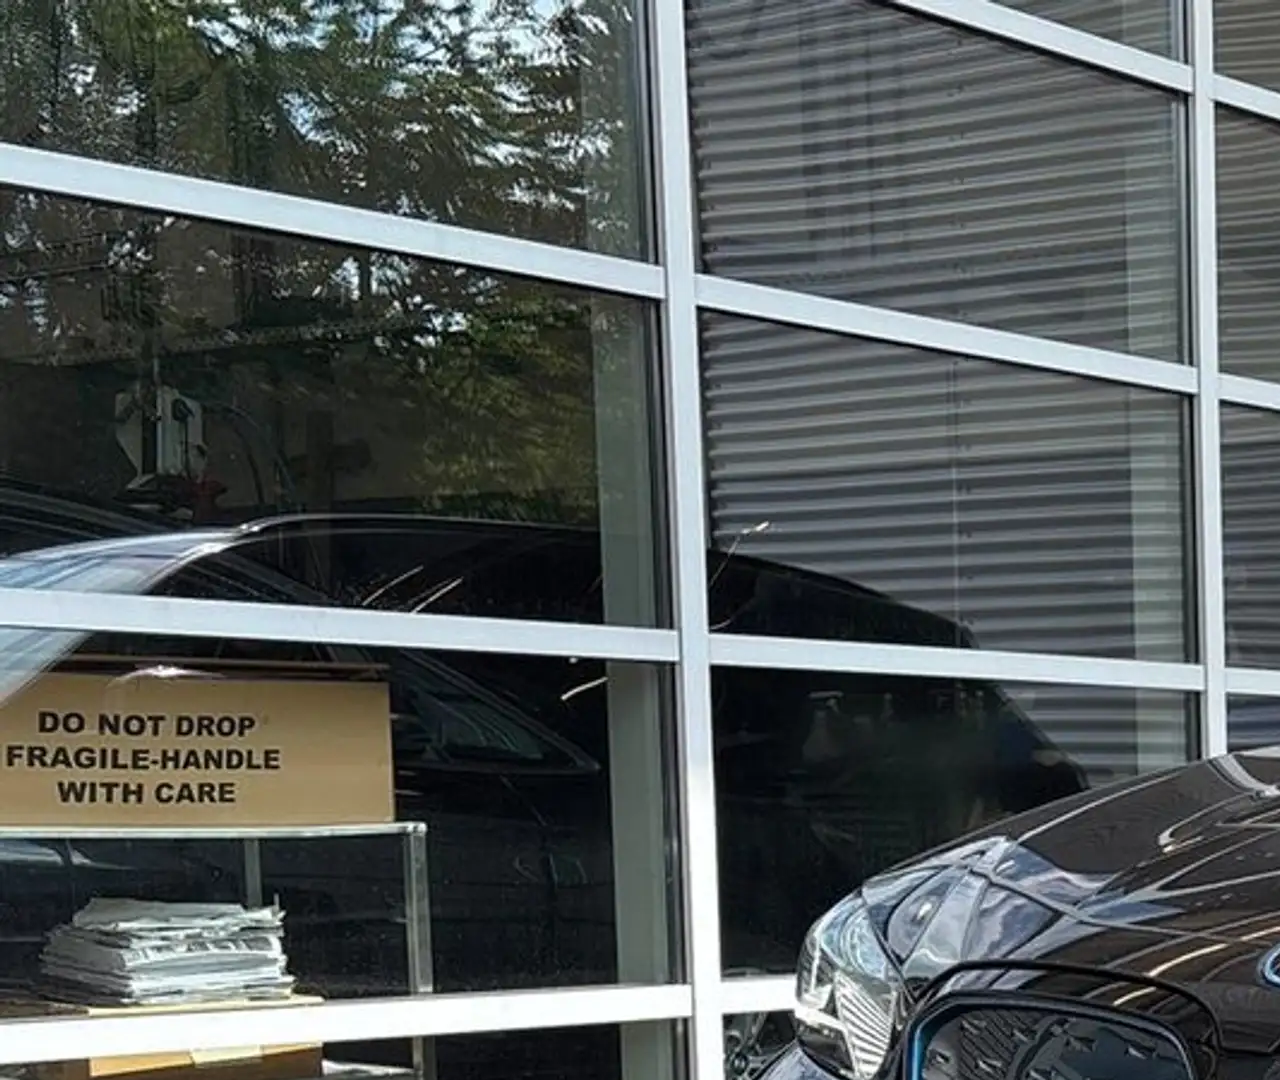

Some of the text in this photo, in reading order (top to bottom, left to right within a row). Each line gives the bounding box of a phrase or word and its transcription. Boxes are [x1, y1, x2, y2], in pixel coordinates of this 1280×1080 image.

[38, 710, 256, 737] DO NOT DROP
[5, 744, 281, 770] FRAGILE-HANDLE
[57, 781, 236, 804] WITH CARE
